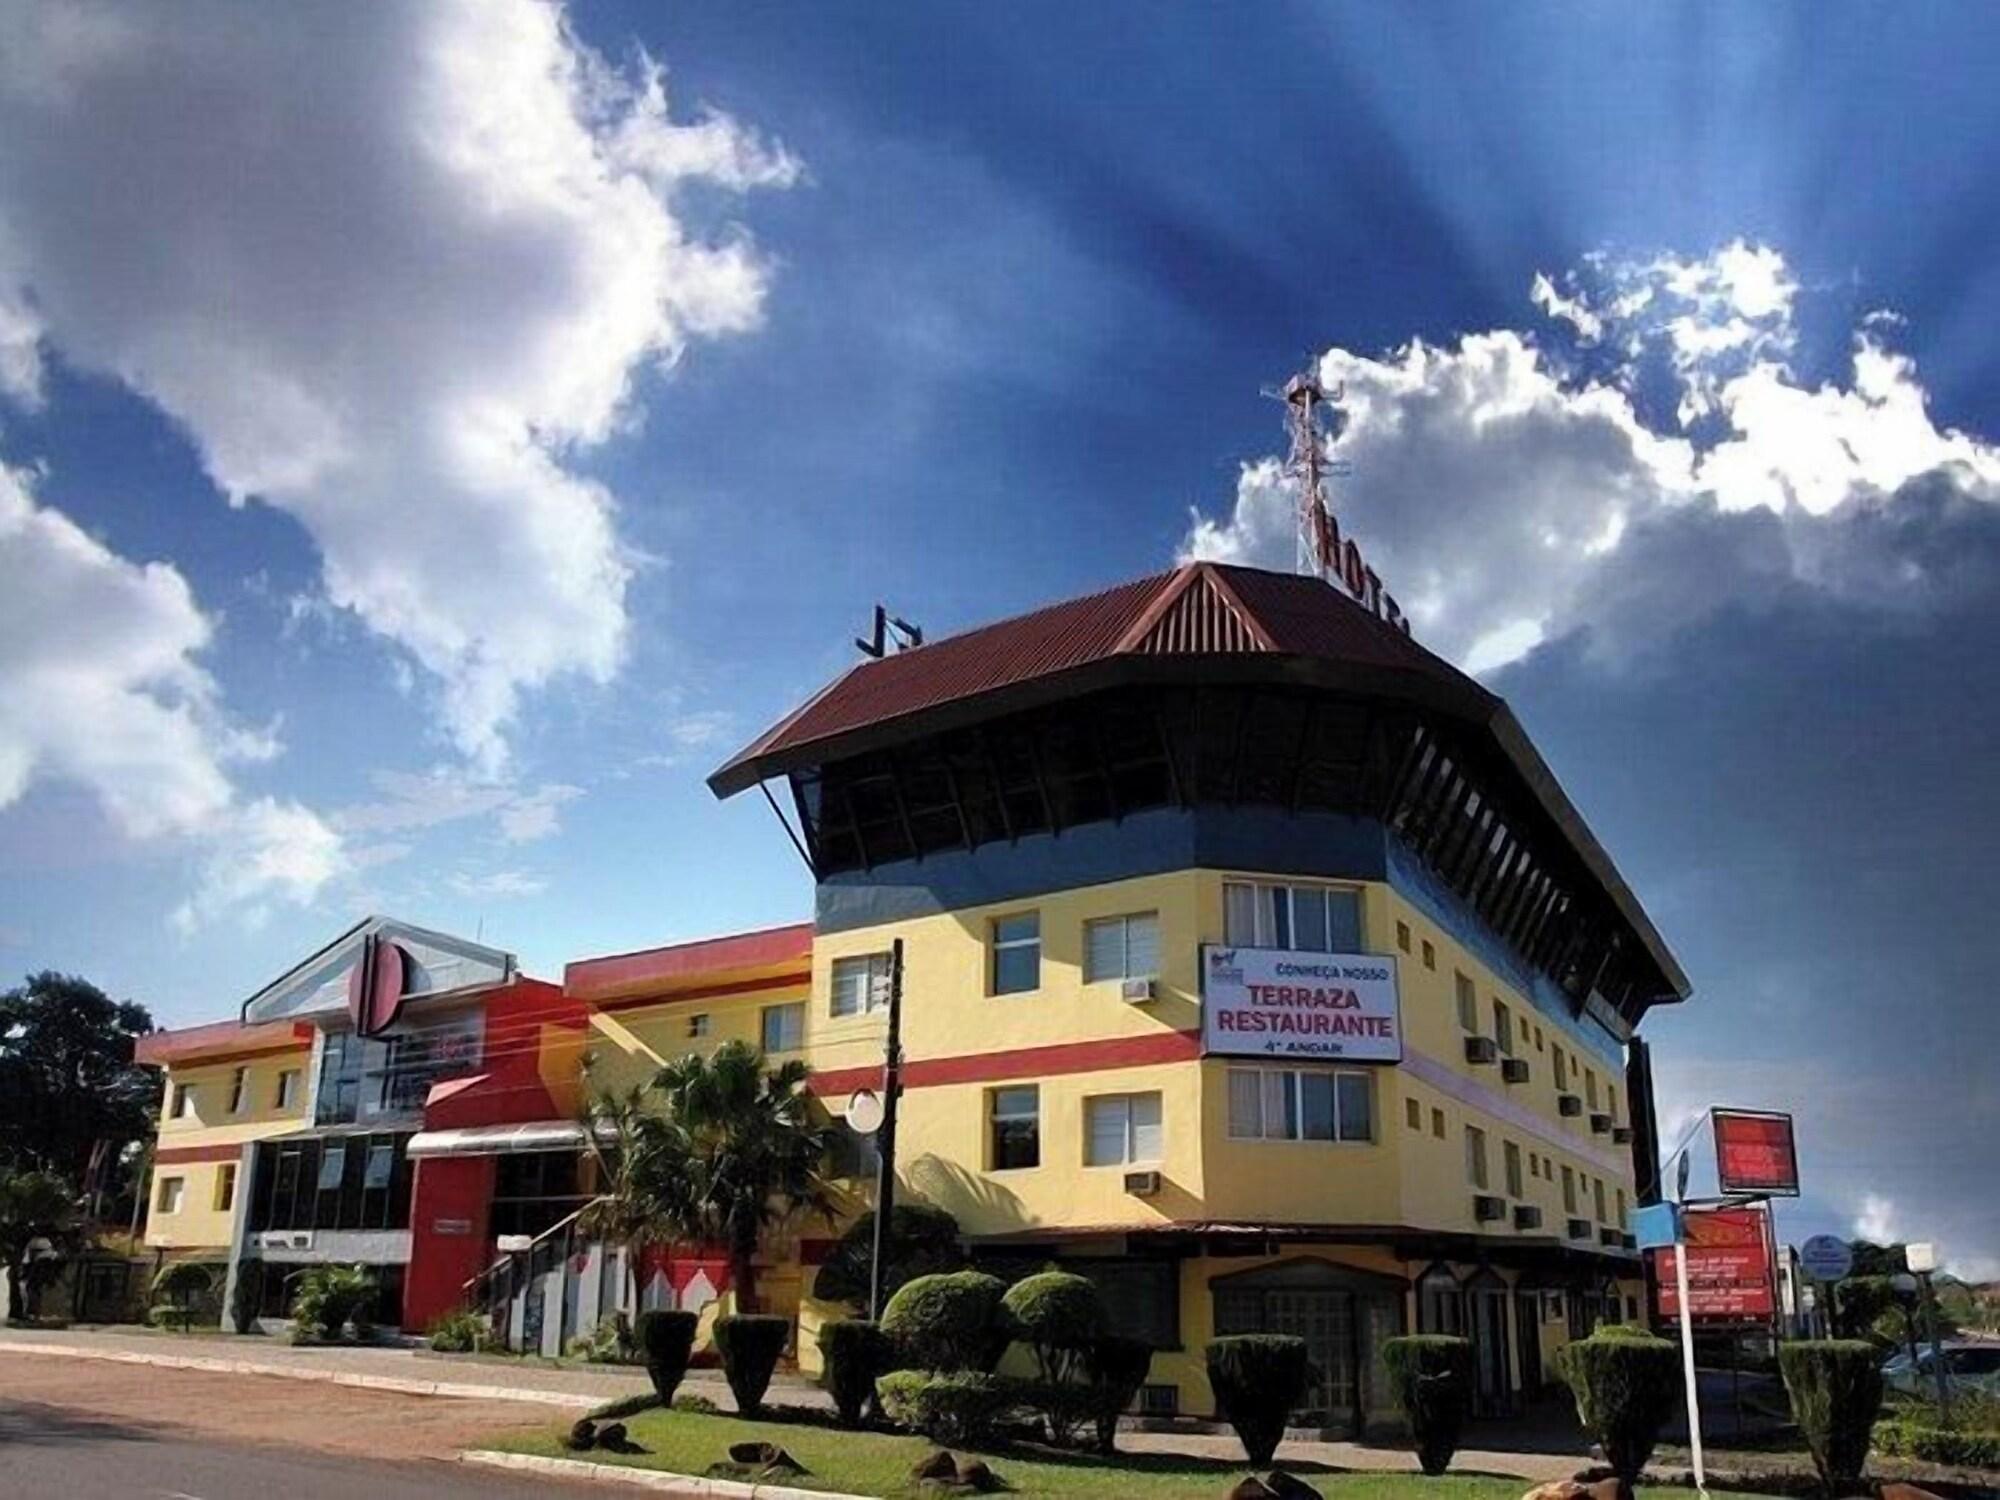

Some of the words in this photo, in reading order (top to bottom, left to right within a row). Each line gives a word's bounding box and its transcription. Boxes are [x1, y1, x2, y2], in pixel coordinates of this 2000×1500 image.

[1275, 962, 1341, 980] CONHEÇA
[1342, 967, 1389, 981] NOSSO
[1246, 984, 1361, 1010] TERRAZA
[1217, 1010, 1393, 1038] RESTAURANTE
[1285, 1042, 1343, 1055] ANDAR
